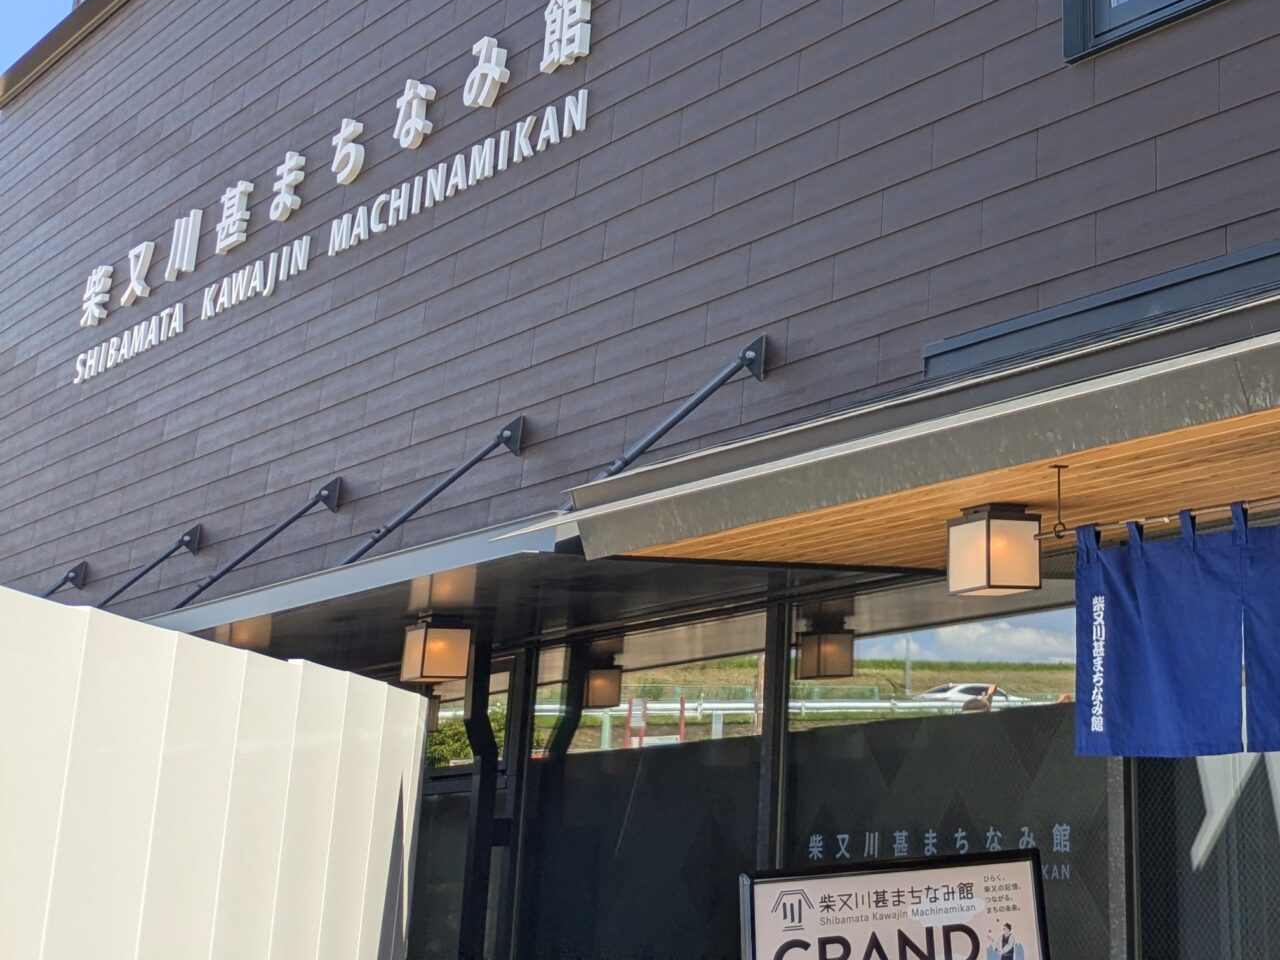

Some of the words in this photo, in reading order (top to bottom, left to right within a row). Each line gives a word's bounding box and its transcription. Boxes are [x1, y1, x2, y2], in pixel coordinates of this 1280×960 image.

[73, 302, 183, 384] SHIBAMATA
[201, 235, 311, 320] KAWAJIN
[328, 89, 588, 256] MACHINAMIKAN
[1091, 595, 1105, 732] 柴又川甚まちなみ館
[808, 823, 1071, 861] 柴又川甚まちなみ館
[1042, 863, 1071, 881] KAN
[819, 882, 975, 914] 柴又川甚まちなみ館
[819, 913, 869, 927] Shibamata
[872, 910, 908, 922] Kawajin
[911, 903, 976, 918] Machinamikan
